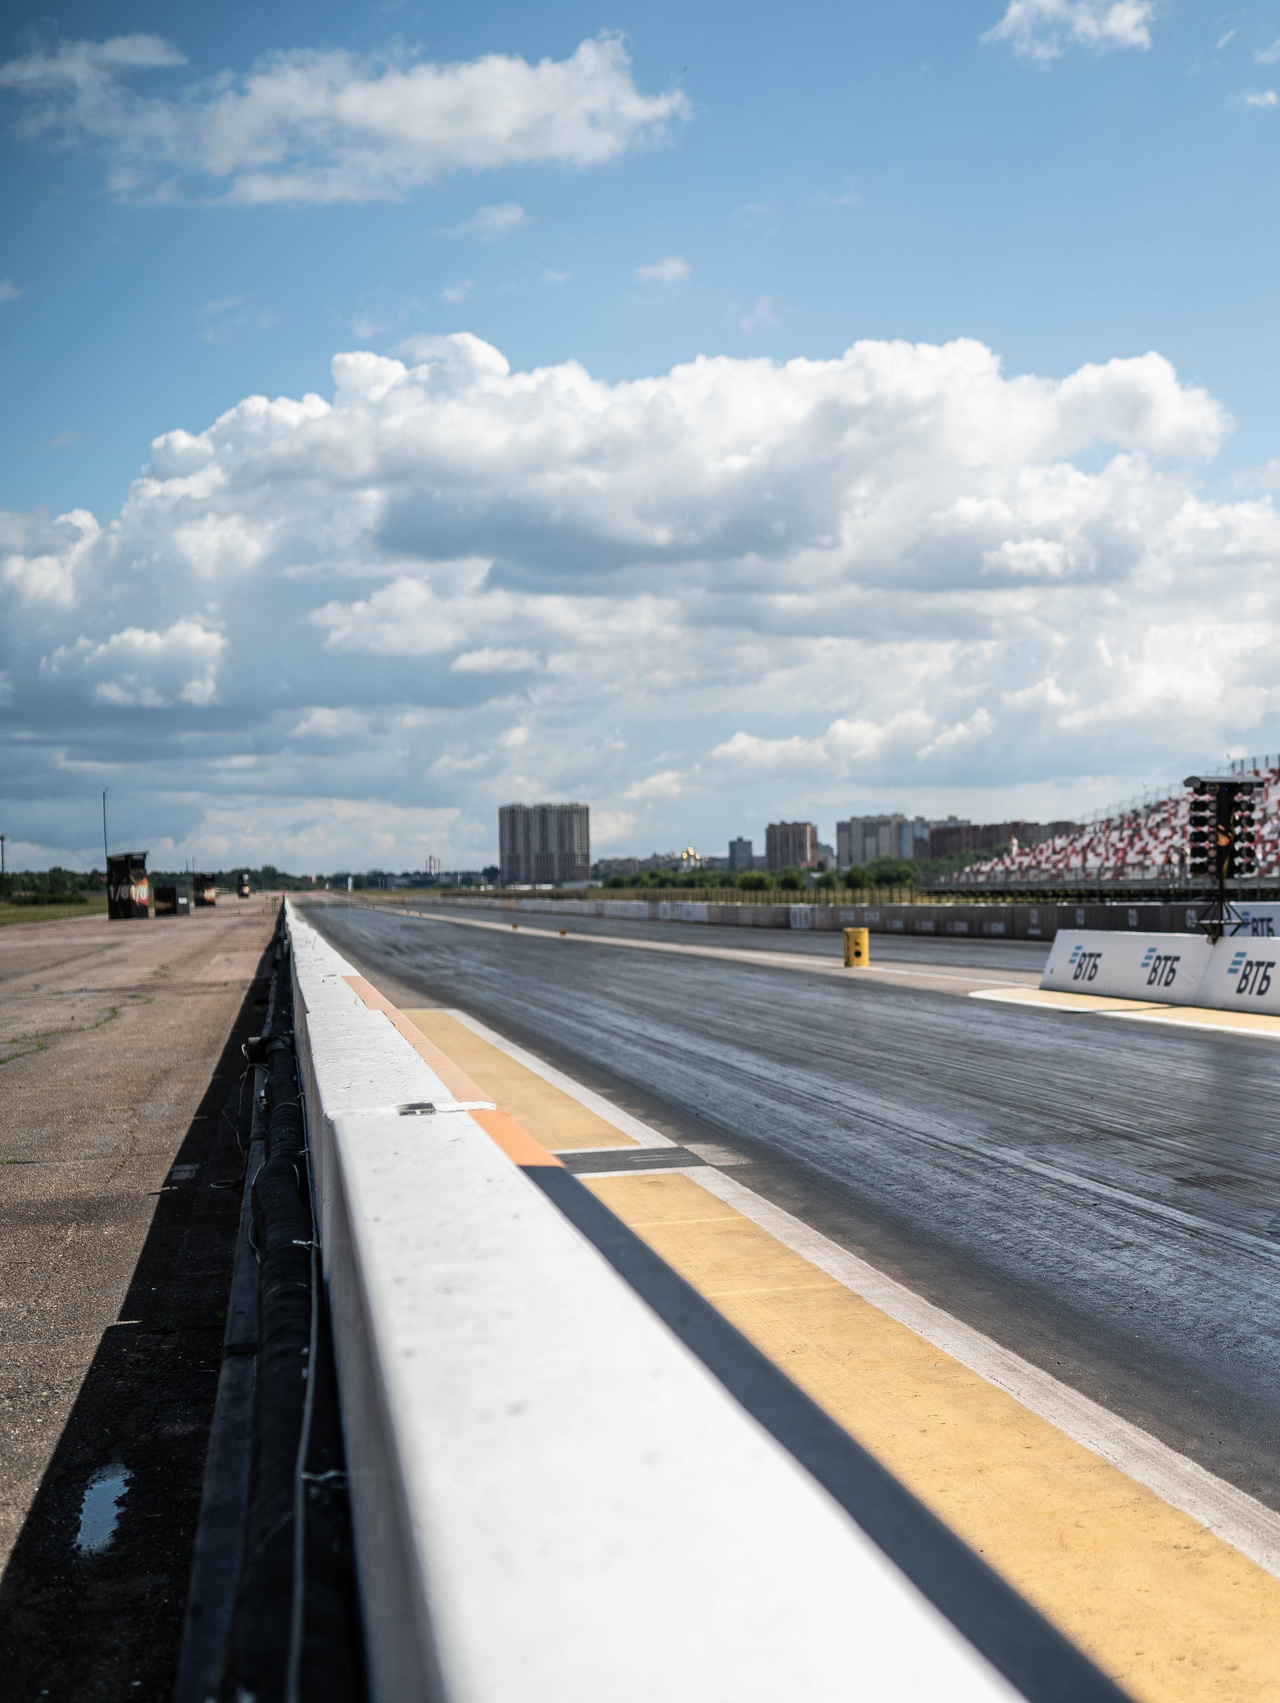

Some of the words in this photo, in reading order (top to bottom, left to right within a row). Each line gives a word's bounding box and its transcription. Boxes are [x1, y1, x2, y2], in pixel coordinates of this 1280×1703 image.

[1073, 953, 1103, 981] ВТБ
[1147, 955, 1181, 987] ВТБ
[1236, 961, 1276, 996] ВТБ
